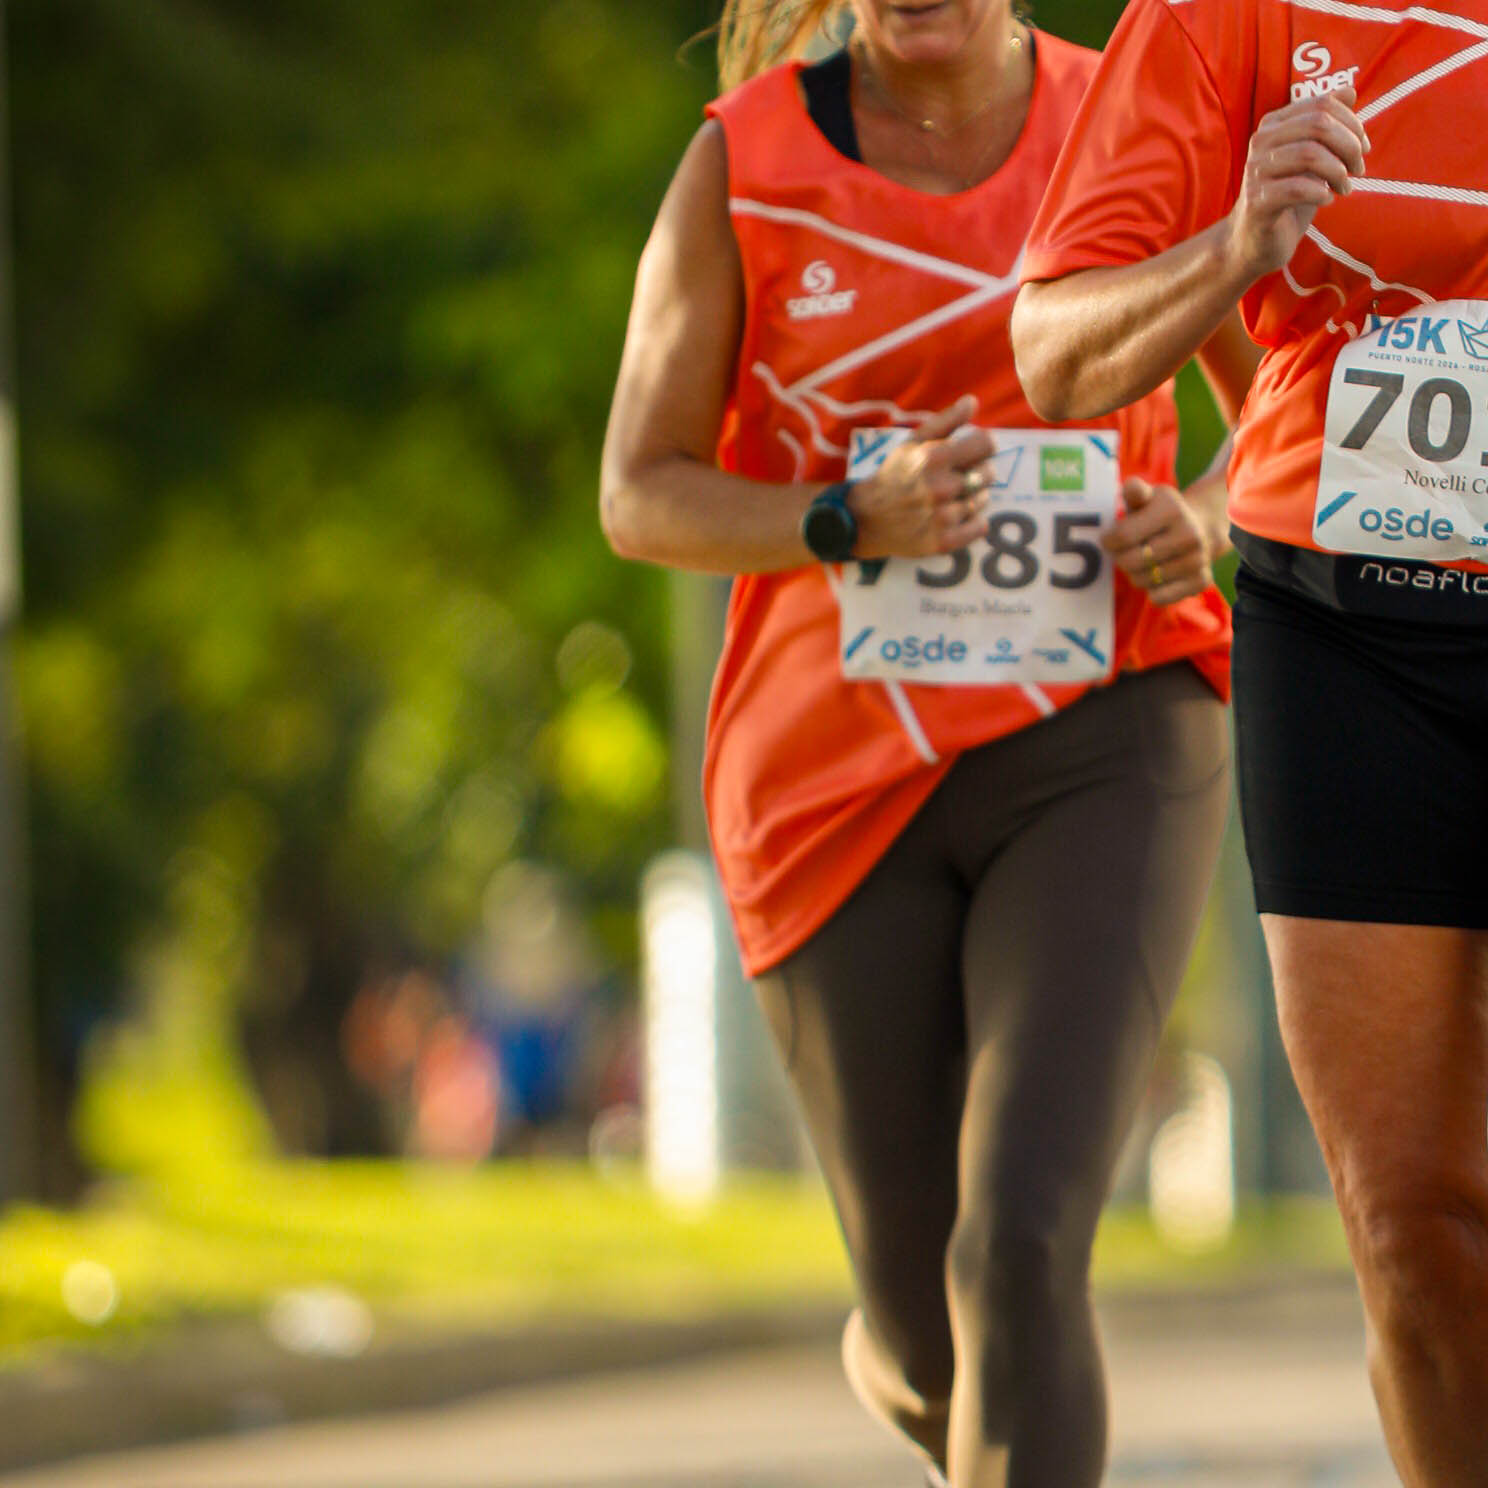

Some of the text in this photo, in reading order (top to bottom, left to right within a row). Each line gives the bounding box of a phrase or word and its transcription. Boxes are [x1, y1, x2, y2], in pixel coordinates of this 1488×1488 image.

[1377, 316, 1450, 354] 15K
[1368, 352, 1402, 361] PUERTO
[1406, 356, 1433, 367] NORTE
[1404, 469, 1466, 493] Novelli
[1359, 507, 1454, 541] osde
[856, 510, 1102, 590] 85
[880, 633, 968, 668] osde
